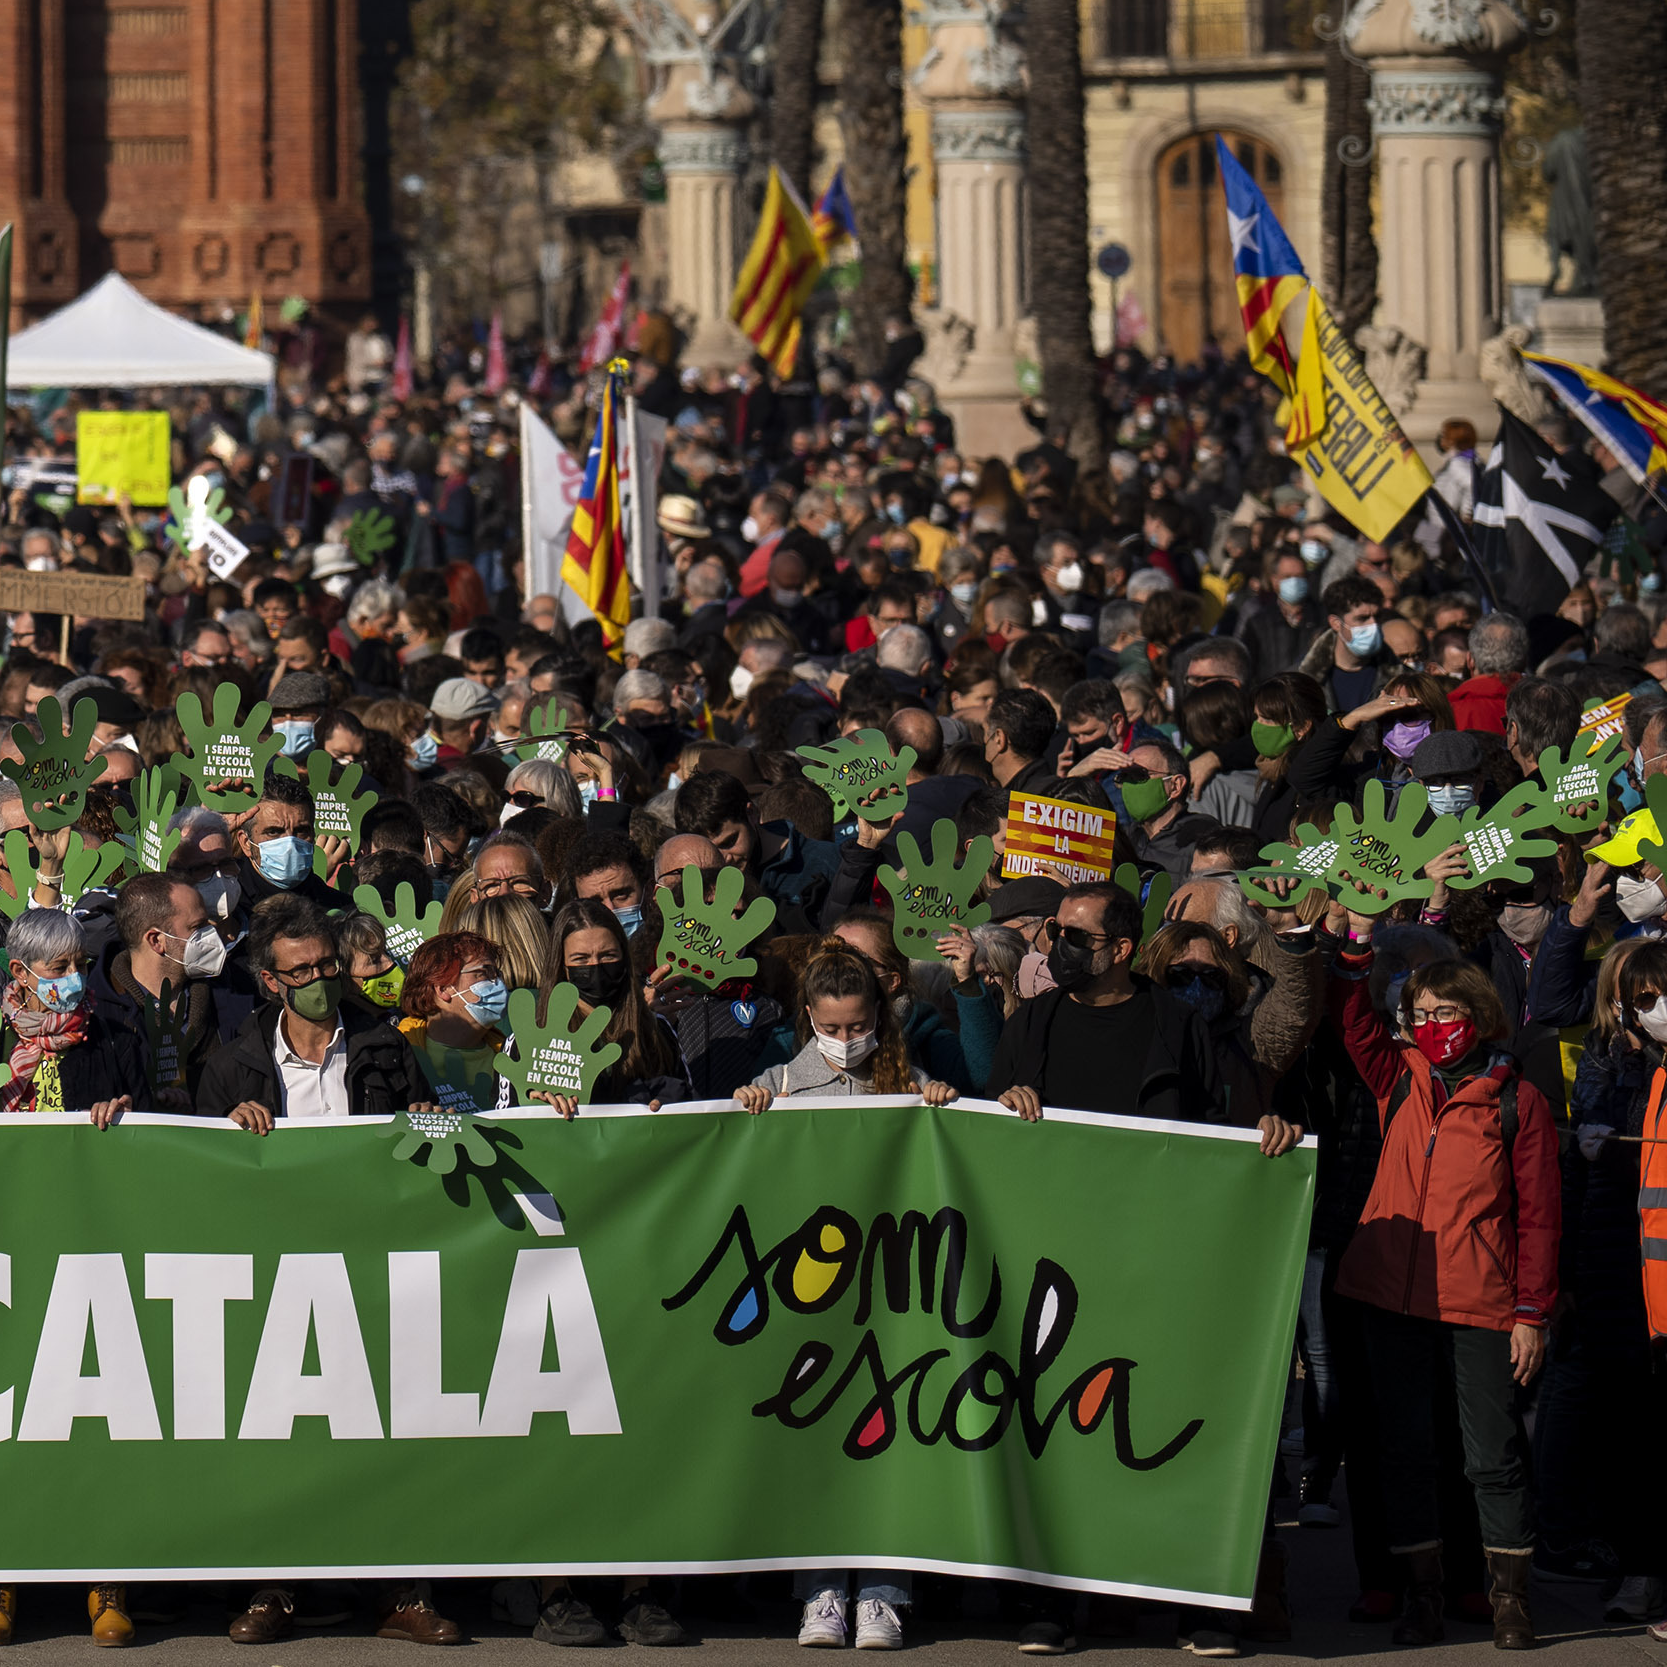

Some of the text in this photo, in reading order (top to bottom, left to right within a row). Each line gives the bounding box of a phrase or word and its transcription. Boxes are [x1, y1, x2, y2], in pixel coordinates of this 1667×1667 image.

[219, 734, 240, 745] ARA
[211, 745, 254, 758] SEMPRE,
[21, 757, 61, 780] som
[207, 756, 251, 767] L'ESCOLA
[831, 757, 869, 780] som
[1571, 763, 1589, 773] ARA
[30, 758, 85, 790] escola
[203, 766, 254, 778] EN CATALÀ
[848, 757, 897, 786] escola
[1562, 769, 1600, 783] SEMPRE,
[1553, 785, 1599, 803] EN CATALÀ
[1557, 778, 1597, 792] L'ESCOLA
[316, 792, 336, 801] ARA
[315, 801, 350, 813] EMPRE,
[318, 820, 352, 831] CATALÀ
[1023, 800, 1104, 838] EXIGIM
[1054, 834, 1070, 855] LA
[1346, 829, 1391, 861] som
[1487, 827, 1508, 864] SEMPRE,
[1499, 828, 1514, 847] ARA
[1464, 830, 1489, 875] EN CATALÀ
[1475, 828, 1497, 867] L'ESCOLA
[1350, 849, 1409, 886] escola
[897, 882, 943, 901] som
[907, 893, 968, 920] escola
[669, 913, 714, 942] som
[674, 931, 733, 965] escola
[549, 1038, 572, 1051] ARA
[532, 1060, 580, 1077] L'ESCOLA
[538, 1050, 585, 1068] SEMPRE,
[434, 1084, 455, 1094] ARA
[526, 1072, 582, 1091] EN CATALÀ
[661, 1204, 1002, 1346] som
[752, 1257, 1205, 1471] escola
